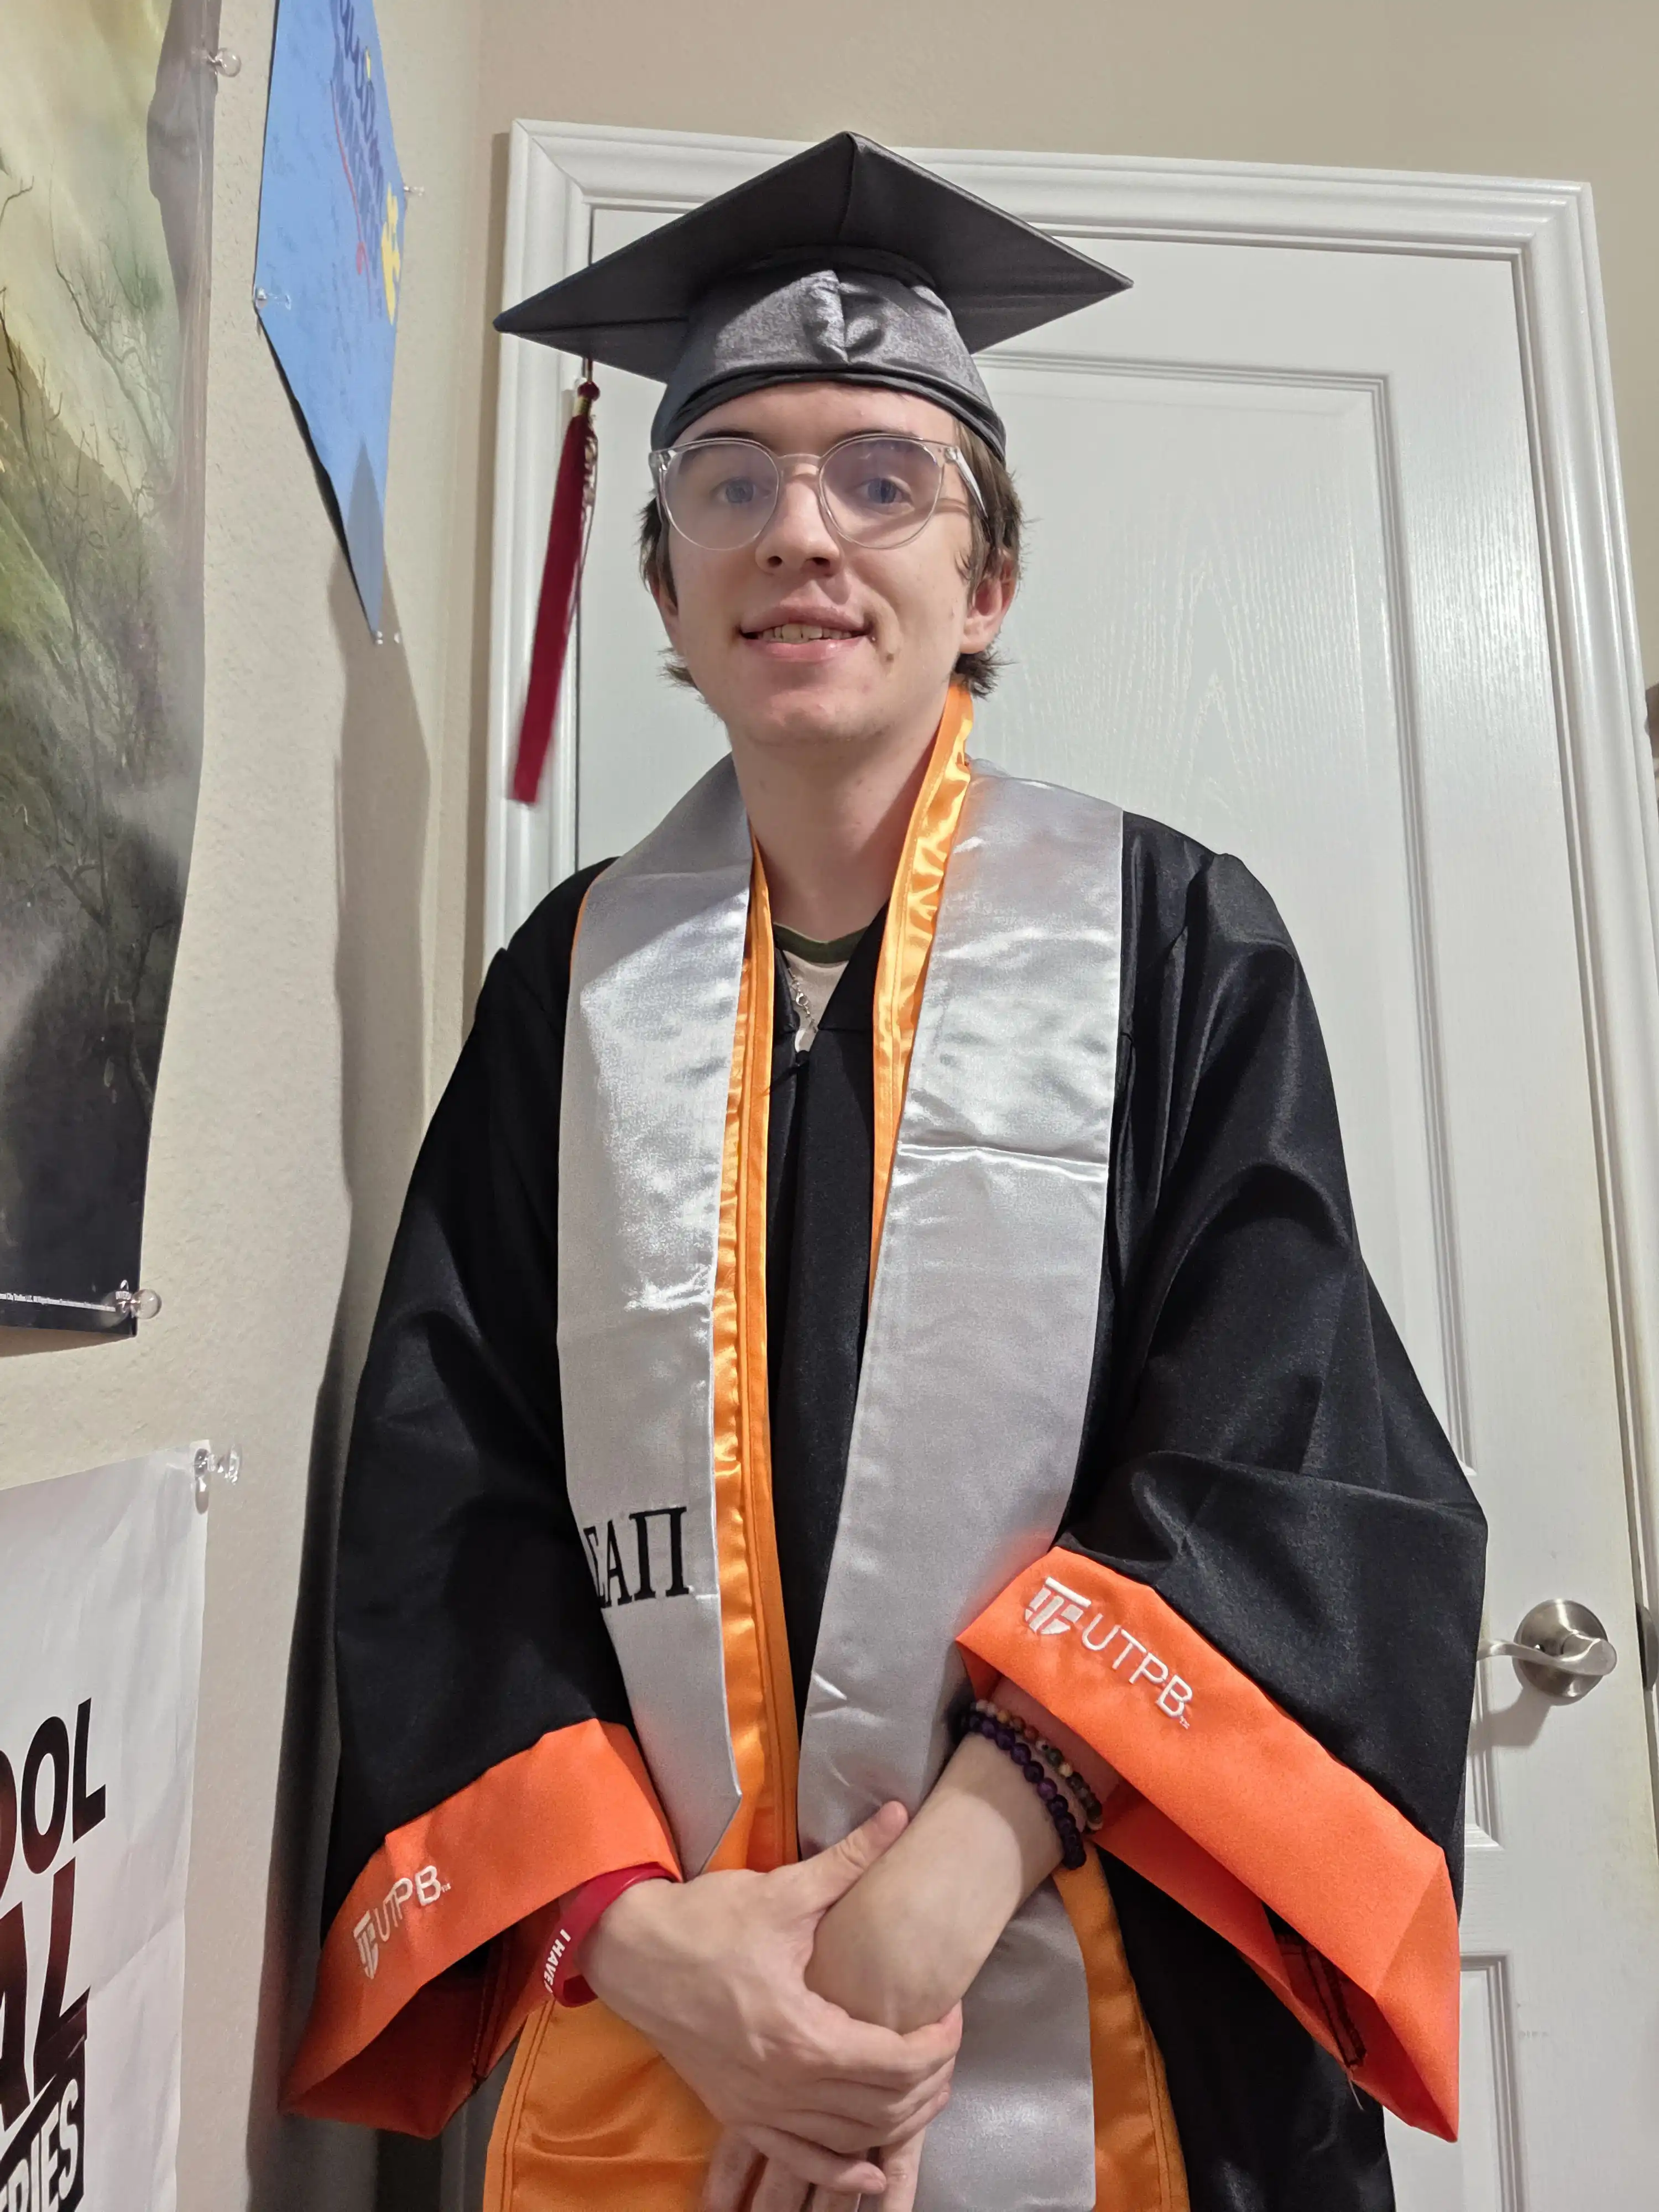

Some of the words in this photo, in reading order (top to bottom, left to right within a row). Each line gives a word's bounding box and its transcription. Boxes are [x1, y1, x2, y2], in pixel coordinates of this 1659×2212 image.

[1082, 1613, 1193, 1718] UTPB
[373, 1865, 441, 1942] UTPB
[544, 1939, 565, 1985] HAVE
[560, 1928, 571, 1942] I
